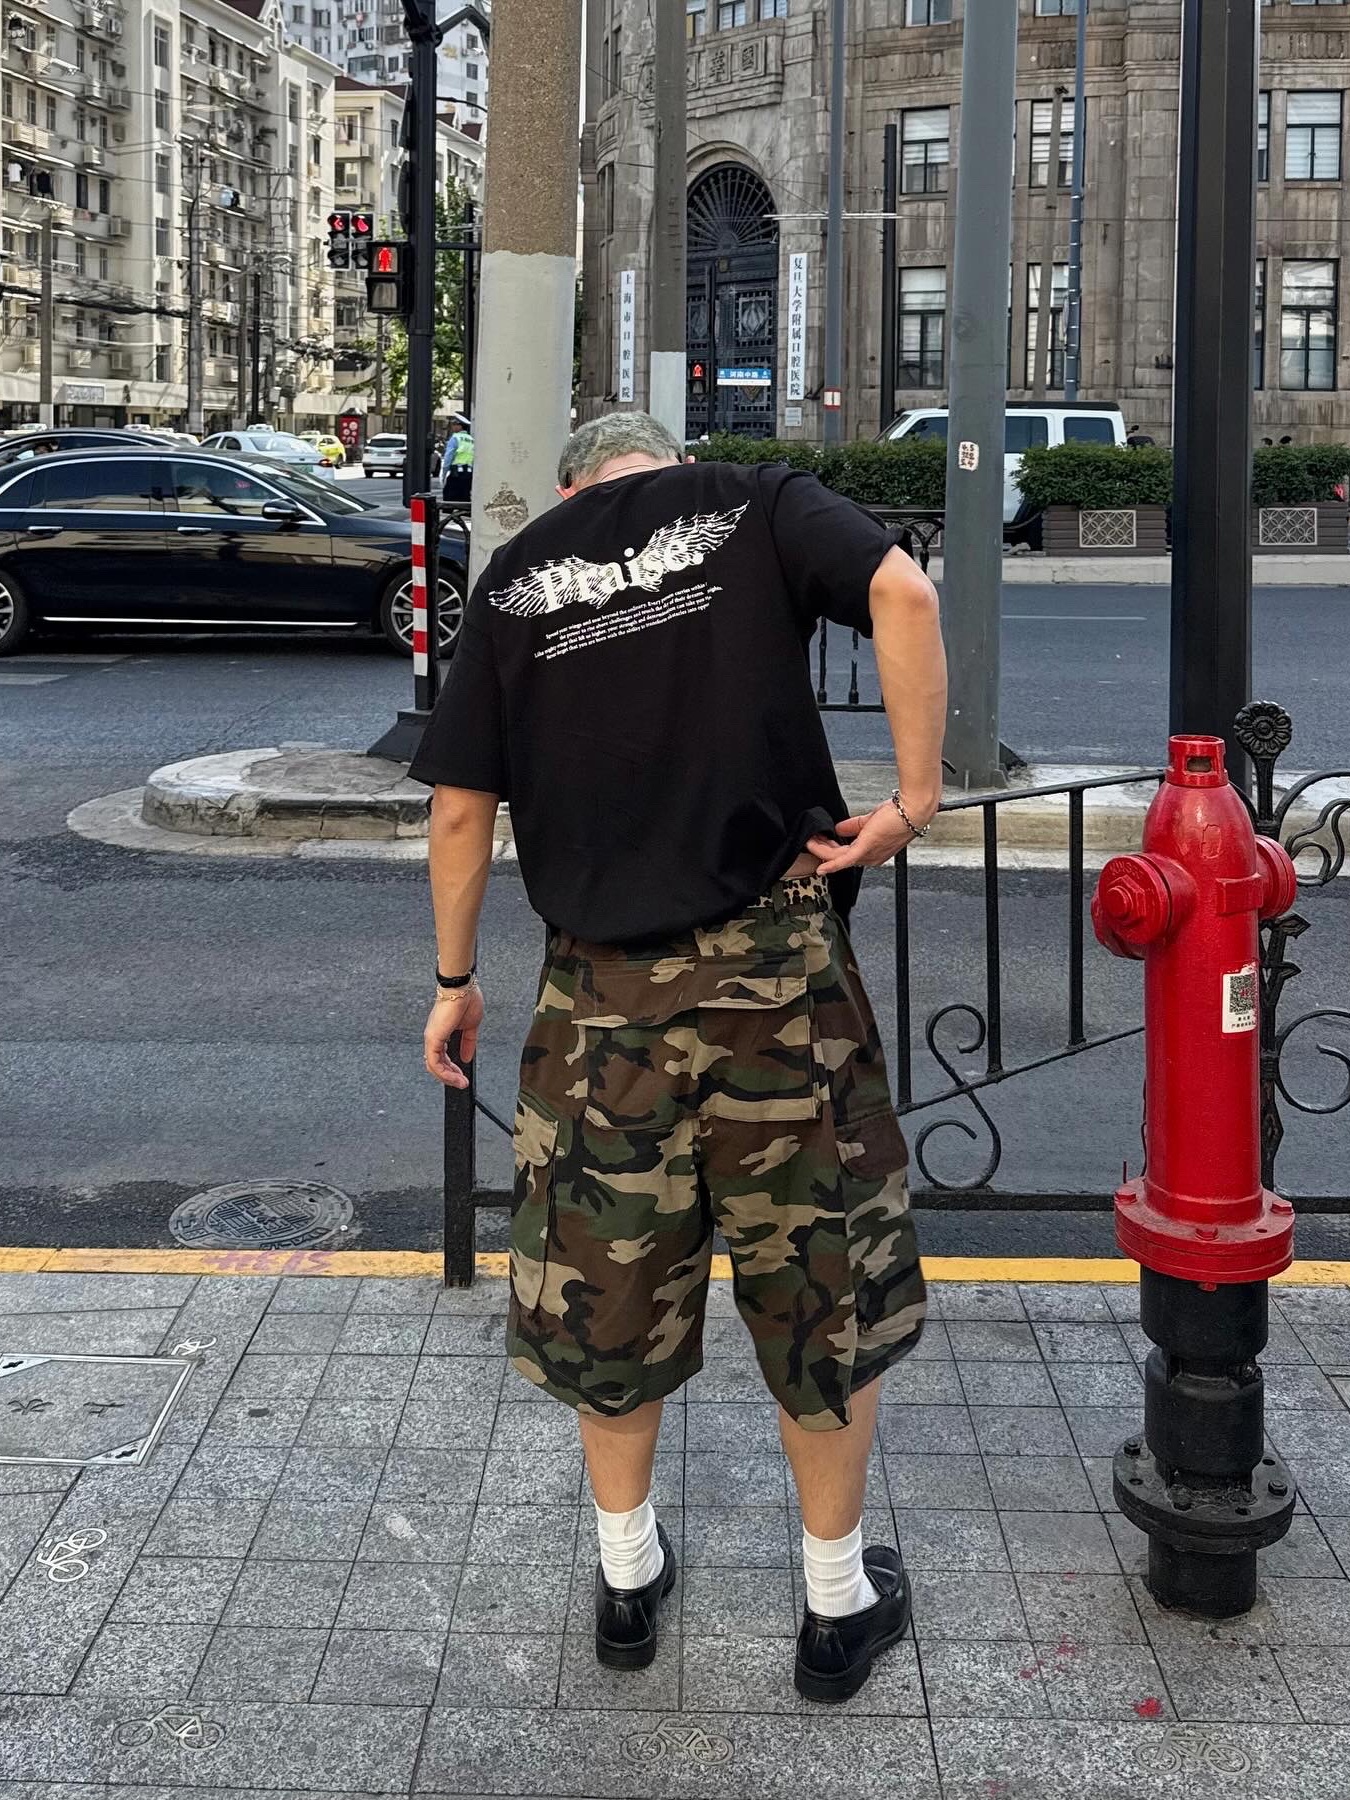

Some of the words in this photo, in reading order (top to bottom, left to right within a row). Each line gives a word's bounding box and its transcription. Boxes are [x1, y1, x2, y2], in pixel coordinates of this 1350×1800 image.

[621, 273, 632, 398] 上海市口腔医院
[790, 257, 803, 396] 复旦大学附属口腔医院
